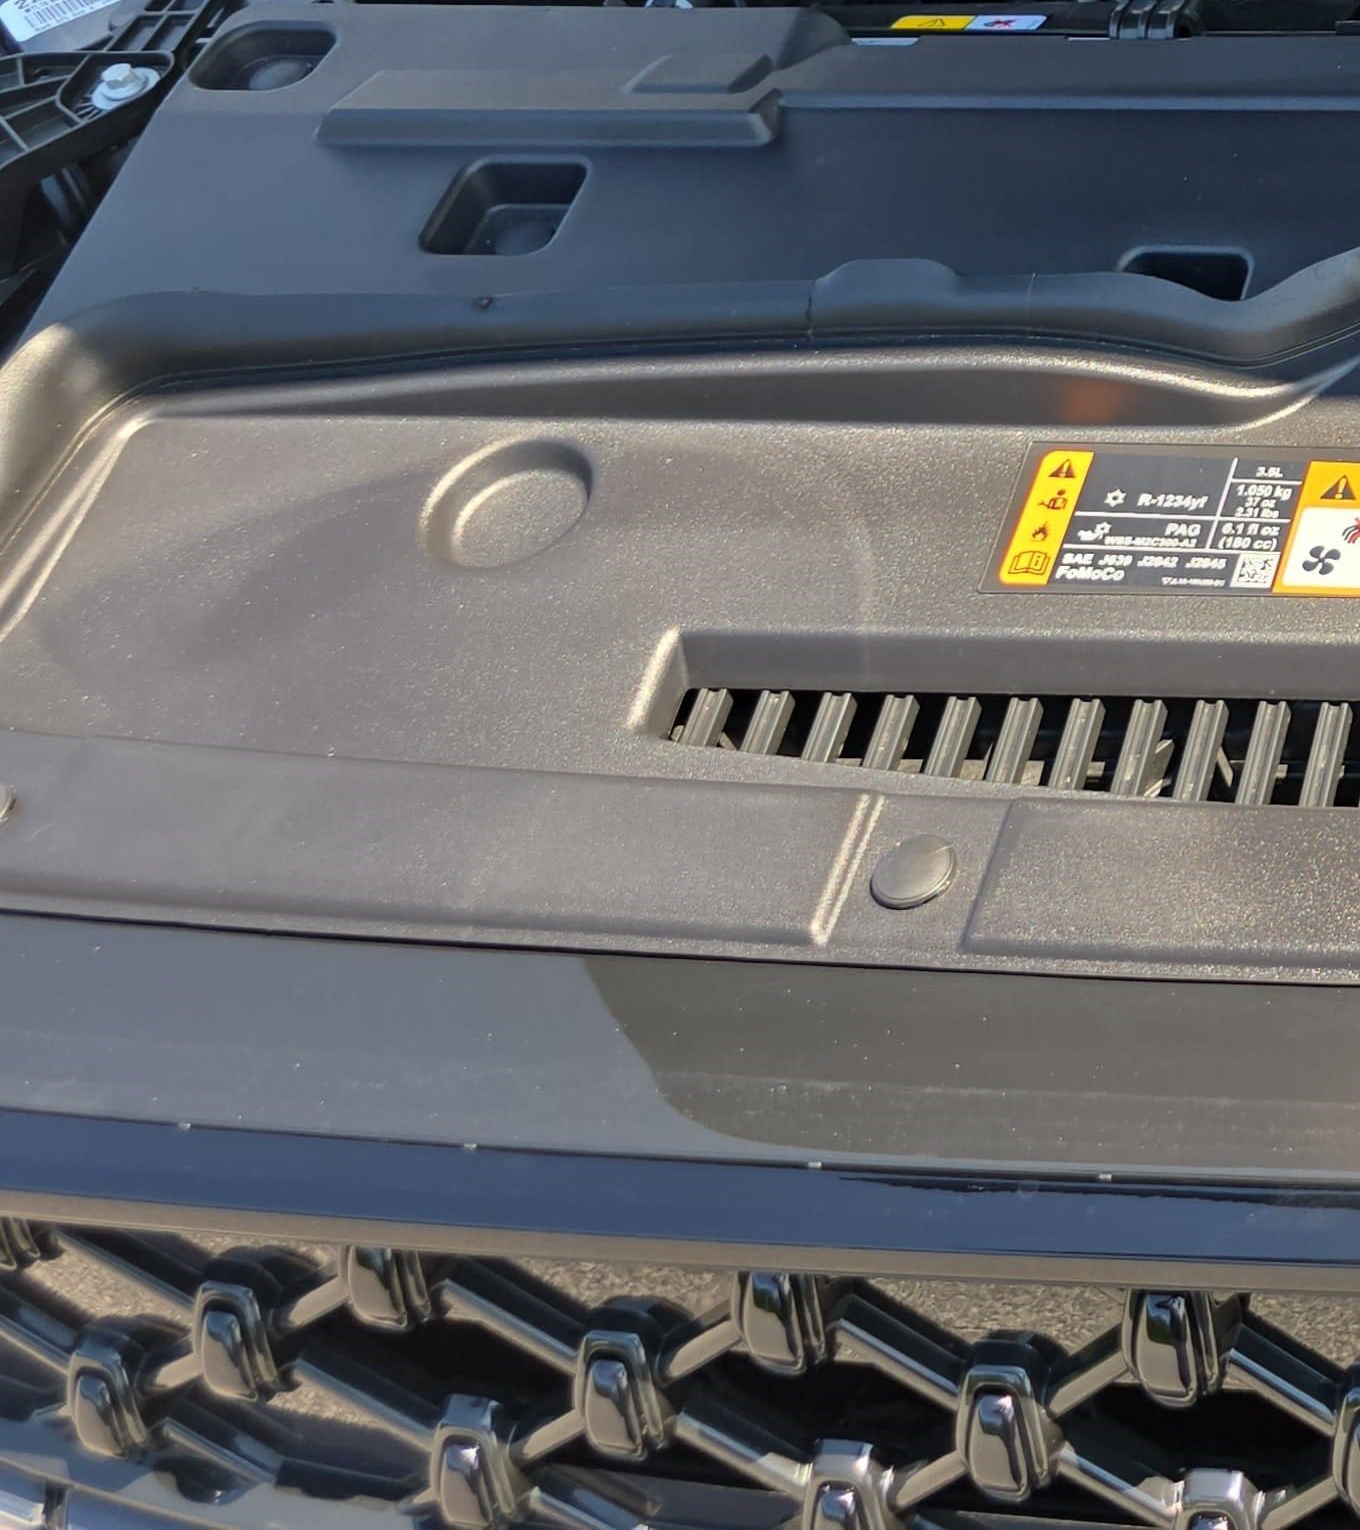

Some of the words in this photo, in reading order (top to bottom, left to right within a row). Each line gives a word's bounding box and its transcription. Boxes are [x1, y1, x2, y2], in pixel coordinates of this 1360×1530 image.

[1236, 484, 1274, 498] 1.050
[1273, 485, 1293, 501] kg
[1136, 493, 1209, 511] R-1234yf
[1244, 496, 1261, 508] 37
[1260, 499, 1277, 509] oz
[1260, 507, 1280, 519] lbs
[1164, 522, 1201, 537] PAG
[1221, 522, 1245, 535] 6.1
[1246, 523, 1260, 536] fl
[1260, 525, 1281, 537] oz
[1217, 536, 1252, 550] (180
[1252, 537, 1278, 551] cc)
[1062, 553, 1095, 565] SAE
[1055, 565, 1125, 581] FoMoCo
